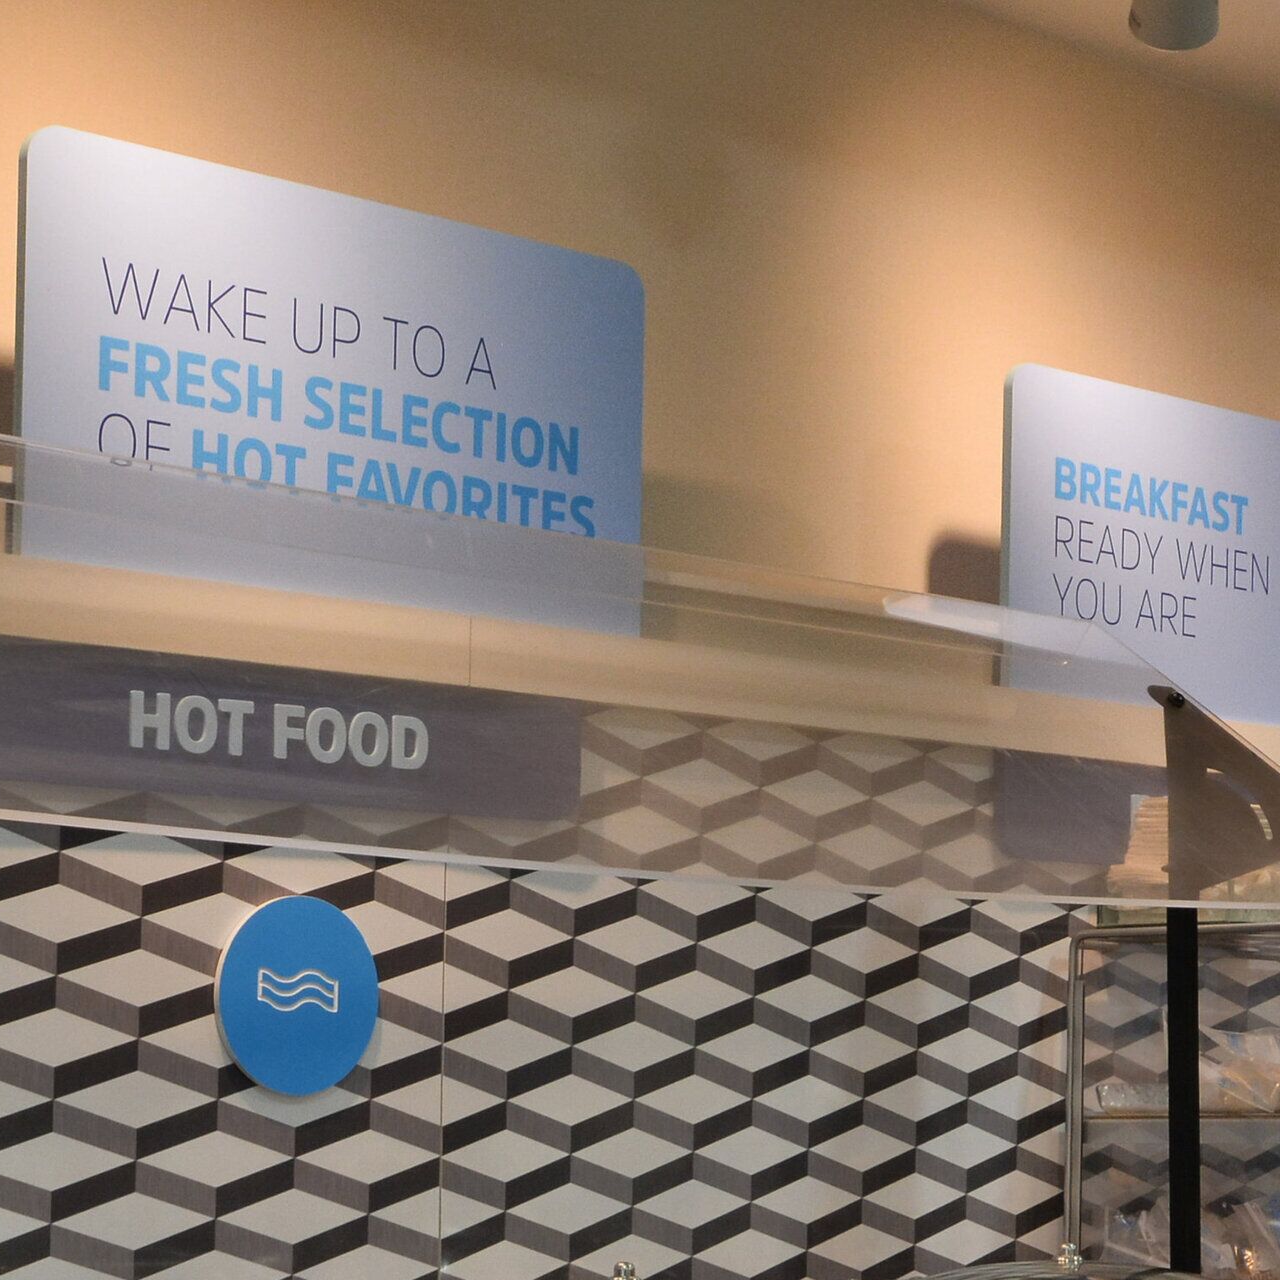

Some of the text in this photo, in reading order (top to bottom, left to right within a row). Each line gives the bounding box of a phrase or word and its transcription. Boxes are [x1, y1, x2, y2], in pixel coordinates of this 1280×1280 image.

[102, 256, 497, 391] WAKE UP TO A
[97, 335, 580, 476] FRESH SELECTION
[98, 412, 596, 539] OF HOT FAVORITES
[1053, 456, 1249, 536] BREAKFAST
[1054, 515, 1270, 596] READY WHEN
[1052, 573, 1197, 639] YOU ARE
[128, 689, 430, 771] HOT FOOD
